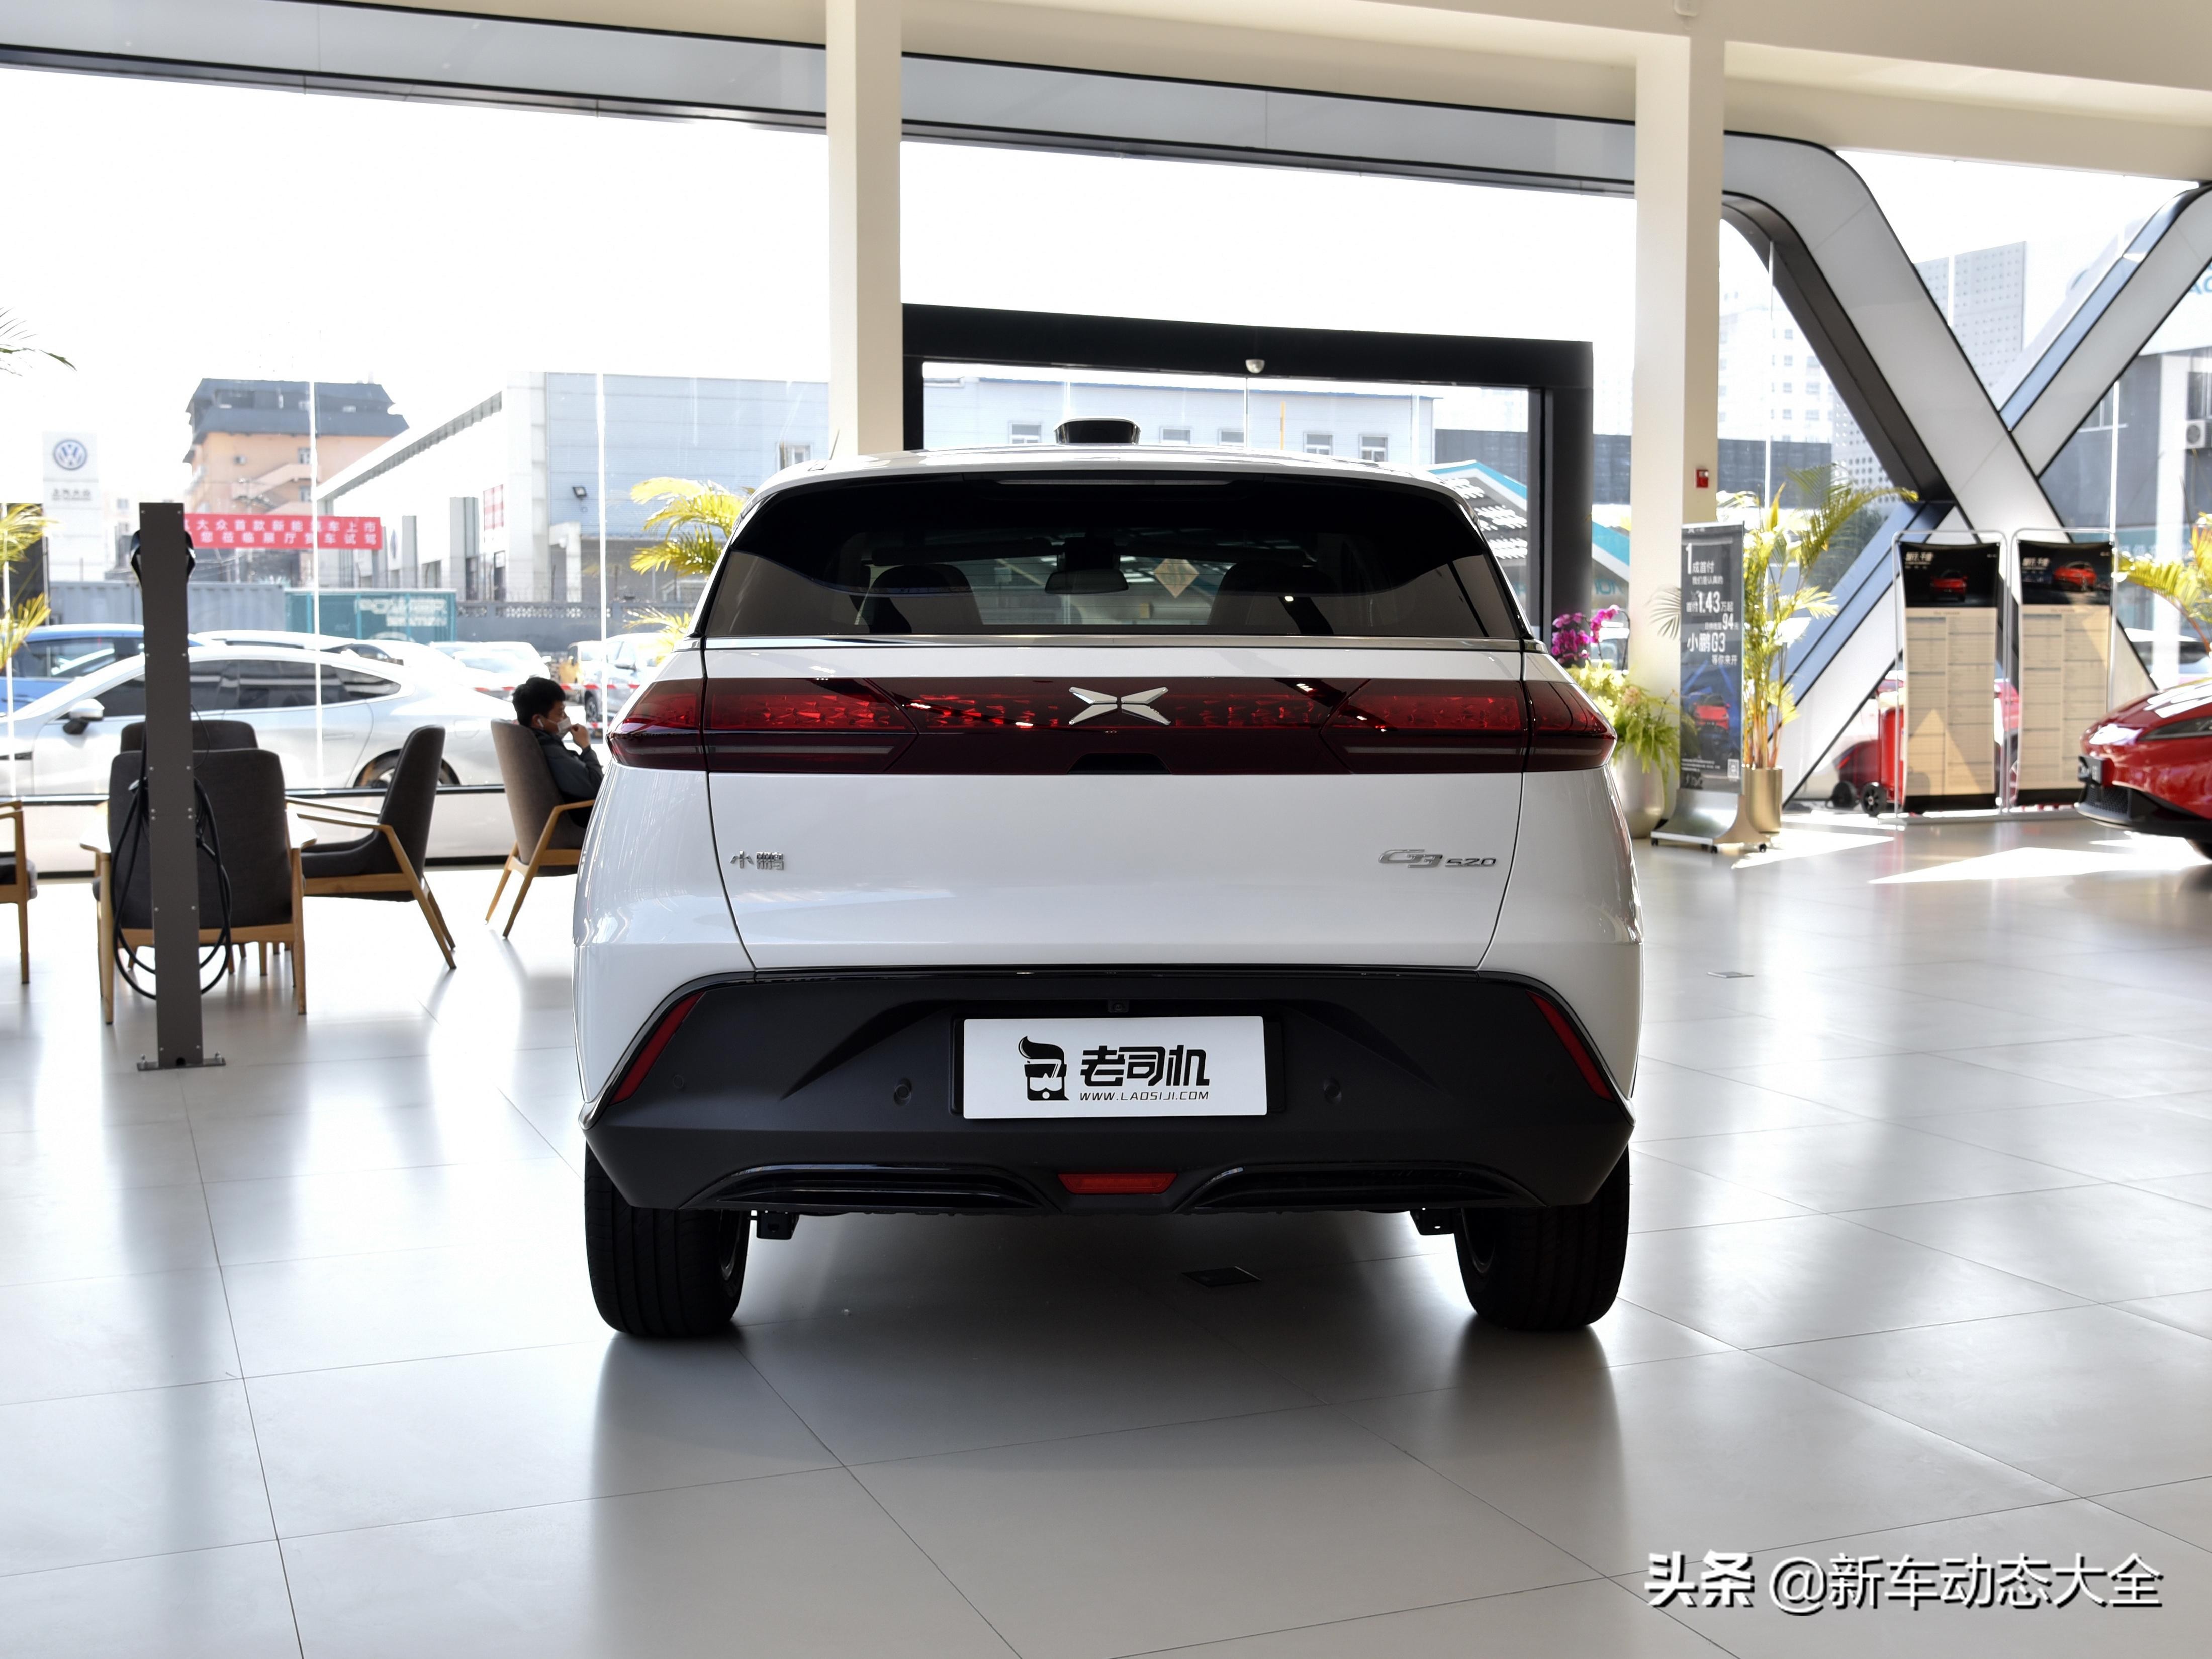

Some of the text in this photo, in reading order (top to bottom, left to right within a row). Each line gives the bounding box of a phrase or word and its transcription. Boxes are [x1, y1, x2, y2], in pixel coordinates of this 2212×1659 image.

[1686, 632, 1726, 653] 小鹏G3
[730, 850, 784, 870] 小鹏
[1444, 858, 1497, 868] 520
[1080, 1045, 1210, 1087] 老司机
[1080, 1091, 1209, 1101] WWW.LAOSIJI.COM
